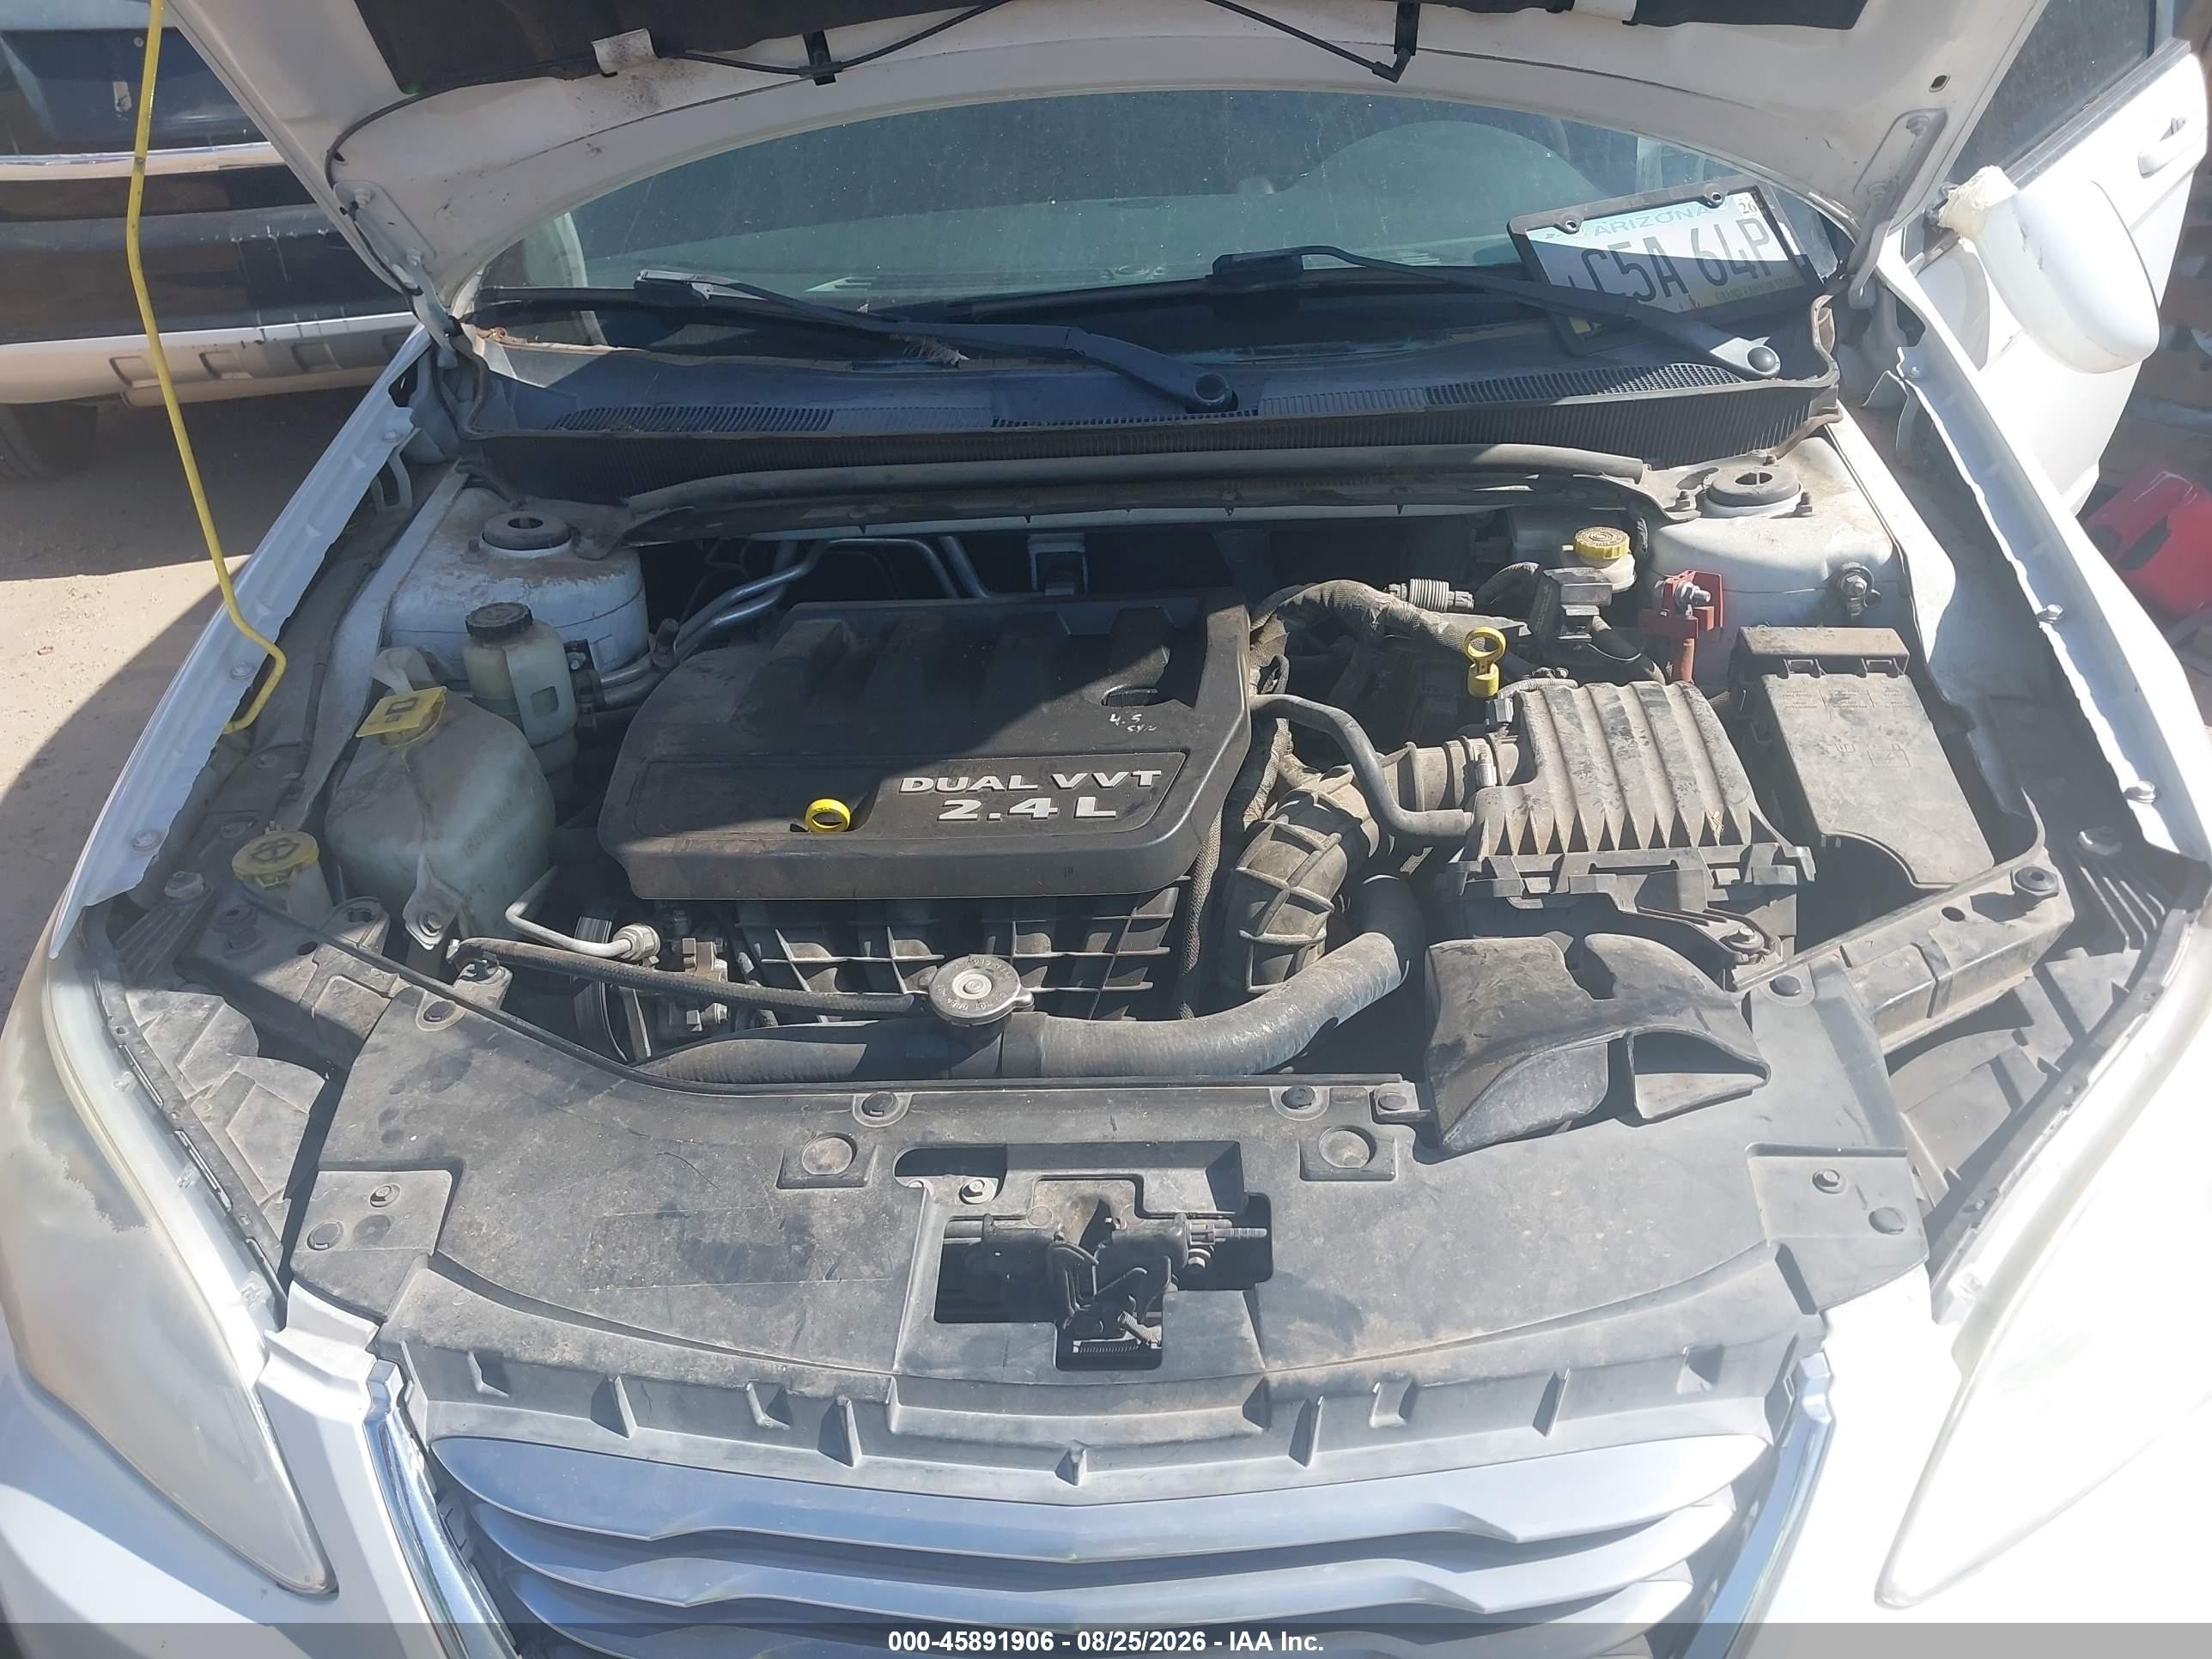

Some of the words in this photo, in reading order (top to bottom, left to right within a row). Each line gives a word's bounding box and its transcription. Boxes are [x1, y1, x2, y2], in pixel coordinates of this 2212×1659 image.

[1738, 200, 1758, 214] 26
[1594, 206, 1711, 237] ARIZONA
[1568, 235, 1689, 301] C5A
[1690, 216, 1772, 286] 64P
[900, 775, 1038, 793] DUAL
[1051, 769, 1162, 789] VVT
[938, 797, 1059, 821] 2.4
